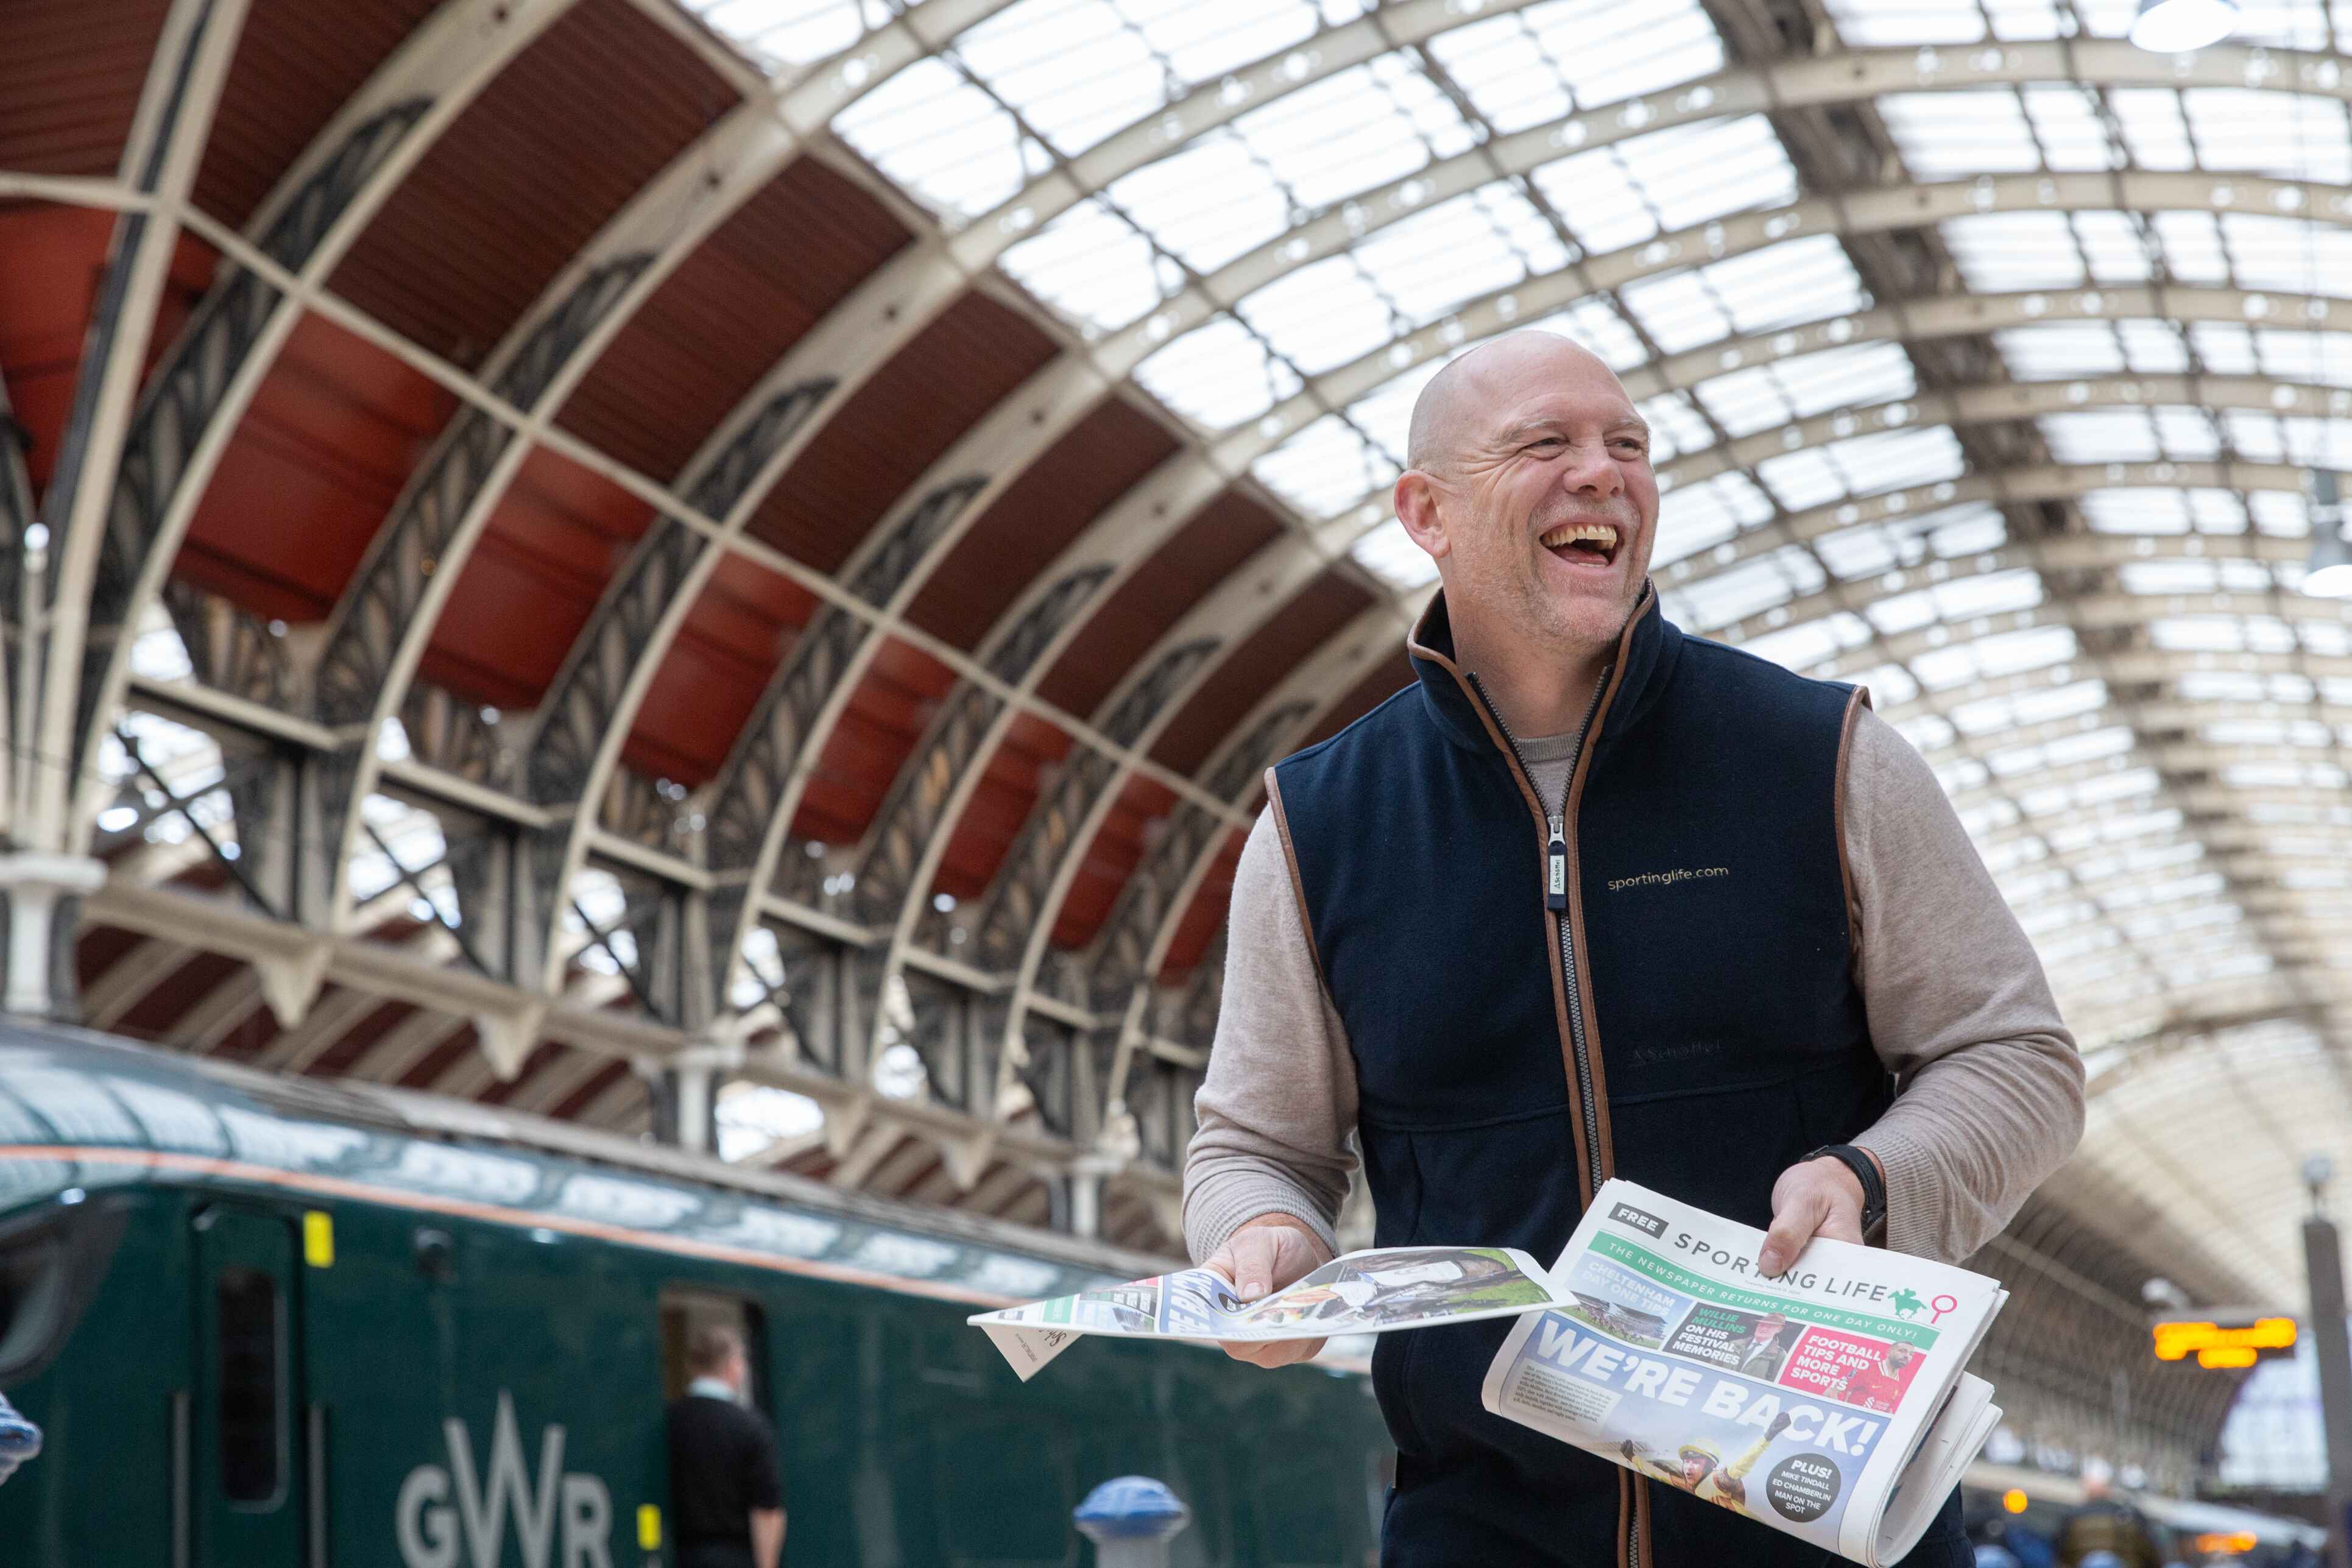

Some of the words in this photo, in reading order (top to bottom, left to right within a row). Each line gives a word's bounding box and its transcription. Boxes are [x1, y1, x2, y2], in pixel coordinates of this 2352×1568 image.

[1608, 867, 1730, 891] sportinglife.com
[1618, 1208, 1659, 1232] FREE
[1674, 1233, 1817, 1289] SPORNG
[1824, 1277, 1887, 1302] LIFE
[1582, 1270, 1609, 1287] DAY
[1611, 1285, 1639, 1302] ONE
[1642, 1298, 1672, 1316] TIPS
[1588, 1262, 1676, 1307] CHELTENHAM
[1609, 1243, 1634, 1259] THE
[1637, 1257, 1715, 1296] NEWSPAPER
[1720, 1291, 1778, 1309] RETURNS
[1782, 1304, 1809, 1316] FOR
[1813, 1311, 1840, 1322] ONE
[1845, 1316, 1873, 1329] DAY
[1877, 1324, 1917, 1340] ONLY!
[1692, 1315, 1747, 1334] MULLINS
[1699, 1308, 1740, 1322] WILLIE
[1678, 1332, 1736, 1352] FESTIVAL
[1686, 1324, 1704, 1335] ON
[1705, 1329, 1729, 1340] HIS
[1672, 1340, 1740, 1365] MEMORIES
[1803, 1344, 1835, 1361] TIPS
[1835, 1354, 1870, 1370] AND
[1807, 1335, 1881, 1361] FOOTBALL
[1796, 1356, 1840, 1376] MORE
[1533, 1319, 1702, 1407] WE'RE
[1702, 1379, 1880, 1457] BACK!
[1790, 1367, 1849, 1391] SPORTS
[395, 1386, 613, 1568] GWR
[1781, 1471, 1800, 1481] MIKE
[1801, 1475, 1829, 1490] TINDALL
[1791, 1460, 1832, 1479] PLUS!
[1775, 1490, 1792, 1501] MAN
[1793, 1496, 1805, 1505] ON
[1806, 1499, 1821, 1510] THE
[1784, 1482, 1831, 1502] CHAMBERLIN
[1785, 1502, 1806, 1514] SPOT
